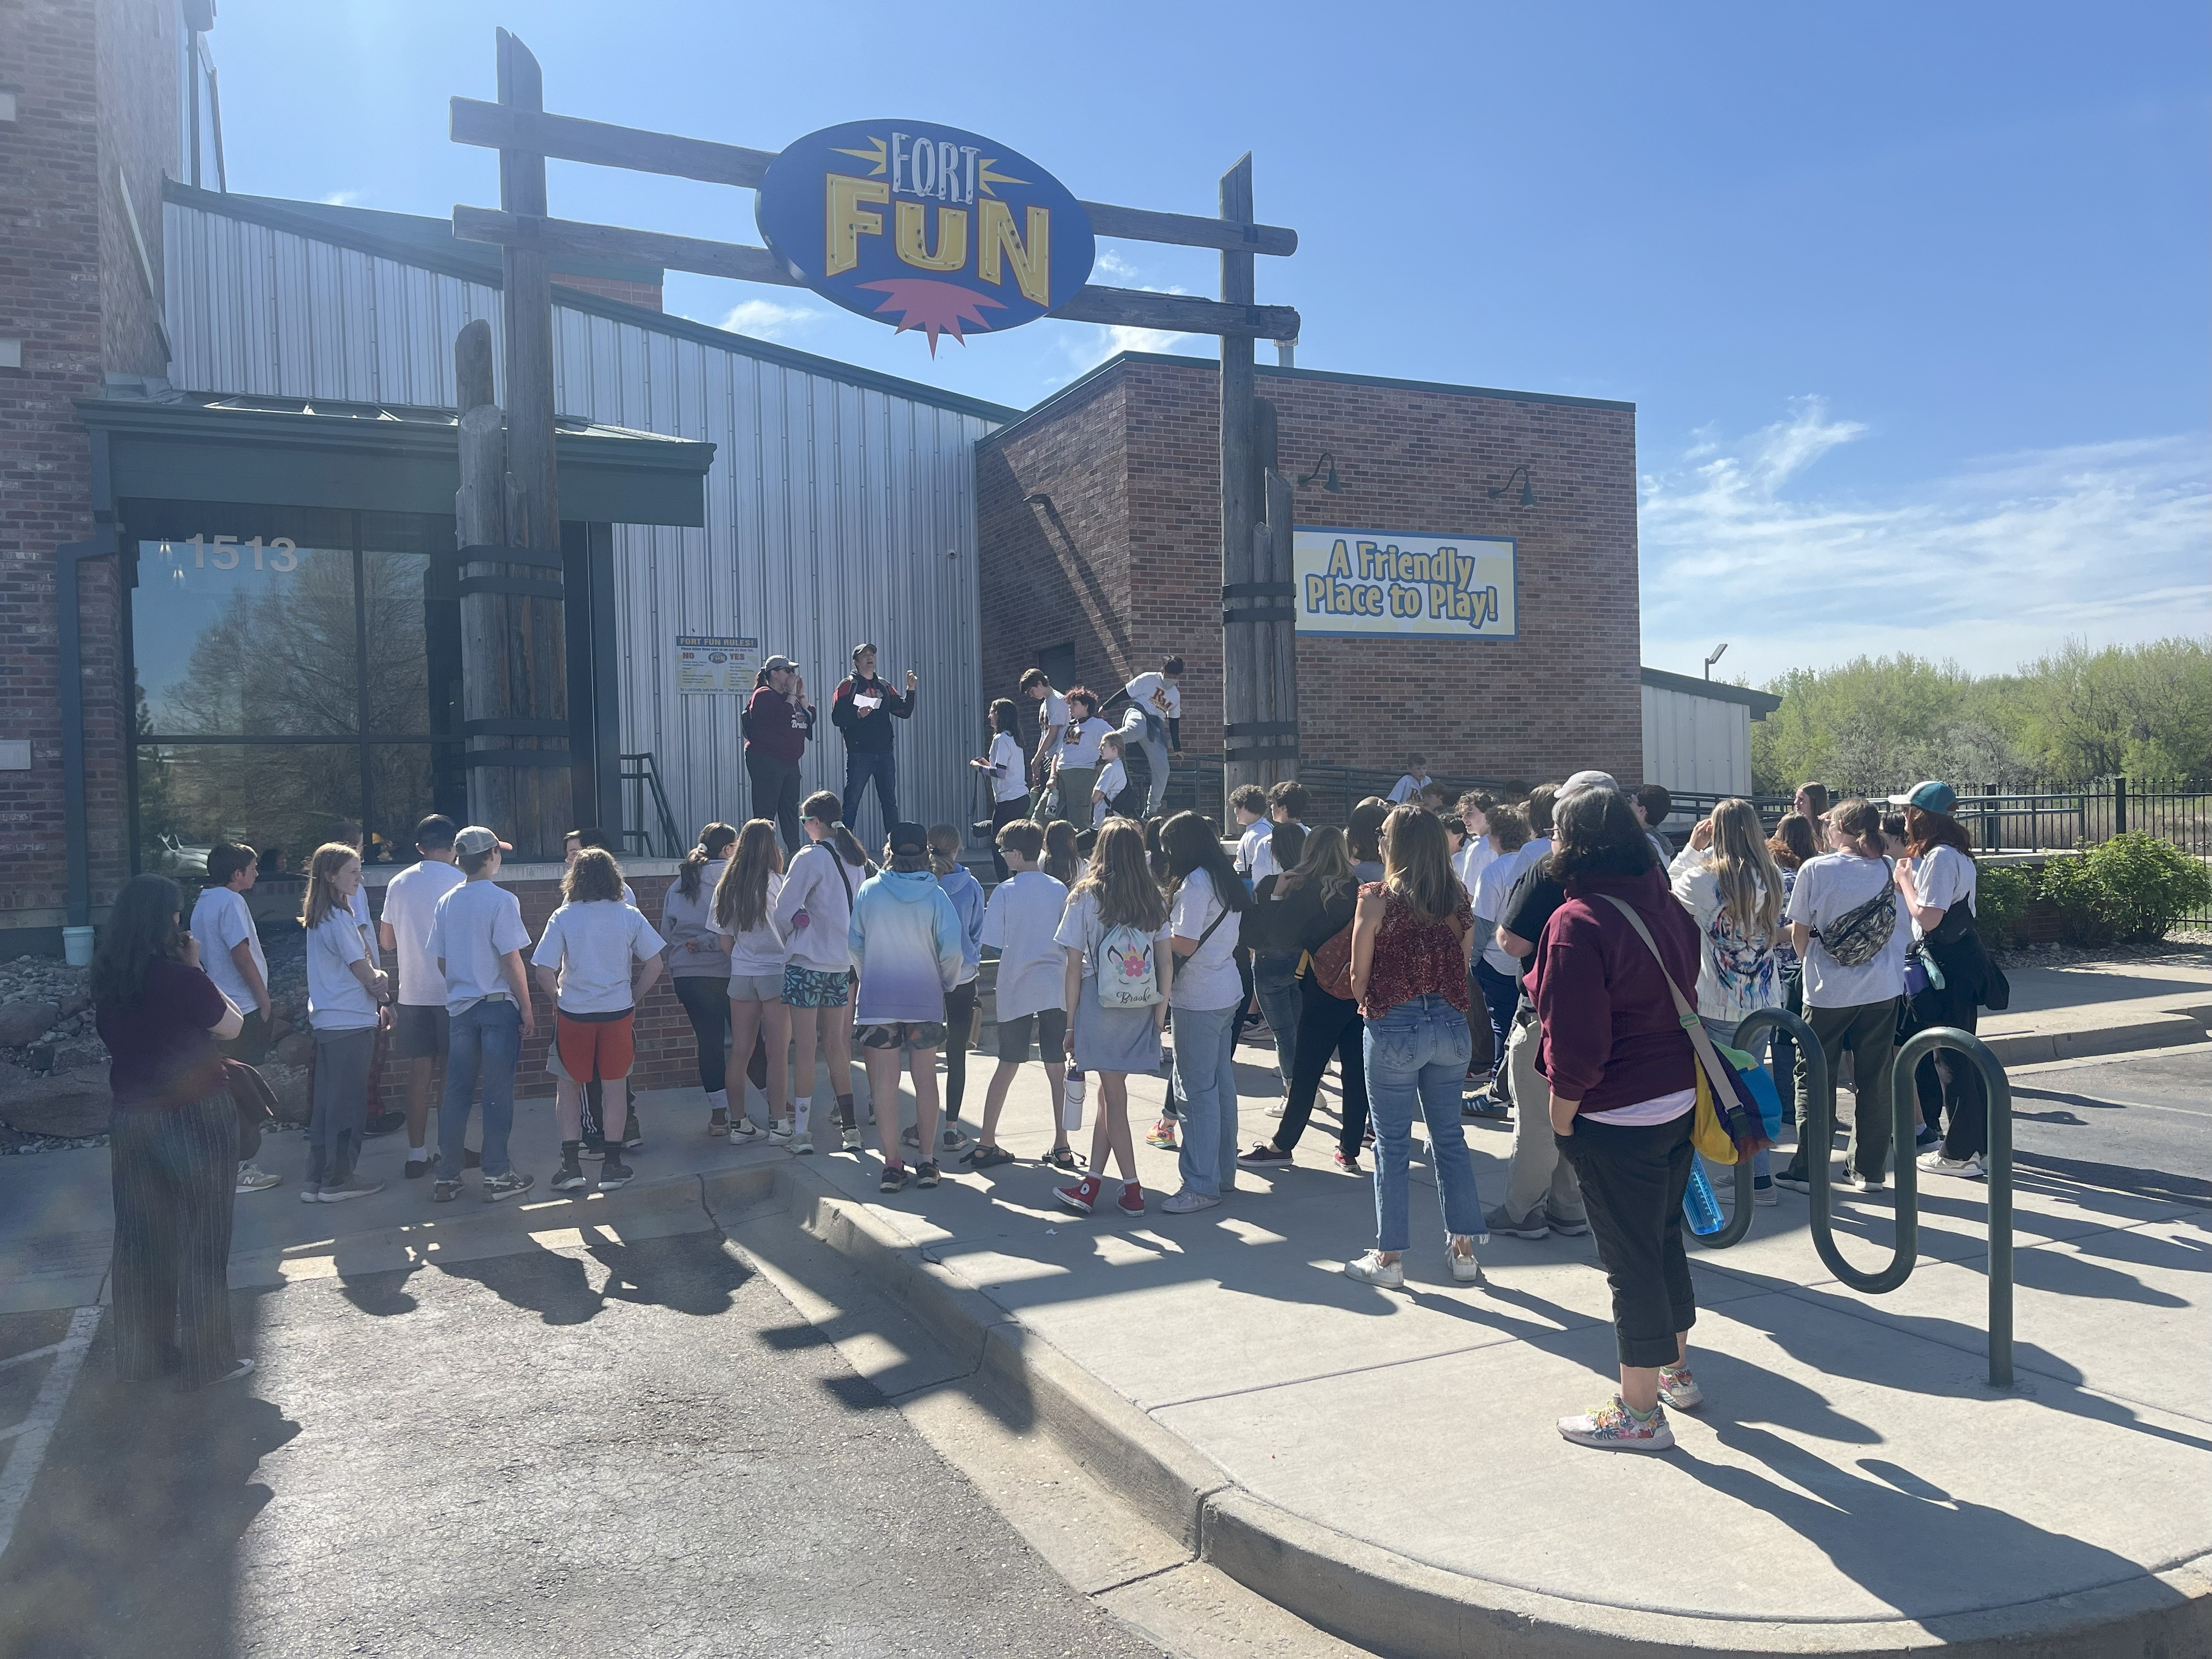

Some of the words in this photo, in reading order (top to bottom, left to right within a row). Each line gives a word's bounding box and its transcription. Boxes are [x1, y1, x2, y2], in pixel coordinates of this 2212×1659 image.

[892, 132, 981, 205] FORT
[826, 172, 1049, 308] FUN
[185, 533, 298, 572] 1513
[1327, 539, 1352, 579] A
[1356, 541, 1475, 591] Friendly
[1306, 574, 1383, 617] Place
[1388, 583, 1422, 618] to
[1428, 583, 1498, 629] Play!
[1116, 987, 1152, 1004] Brooke
